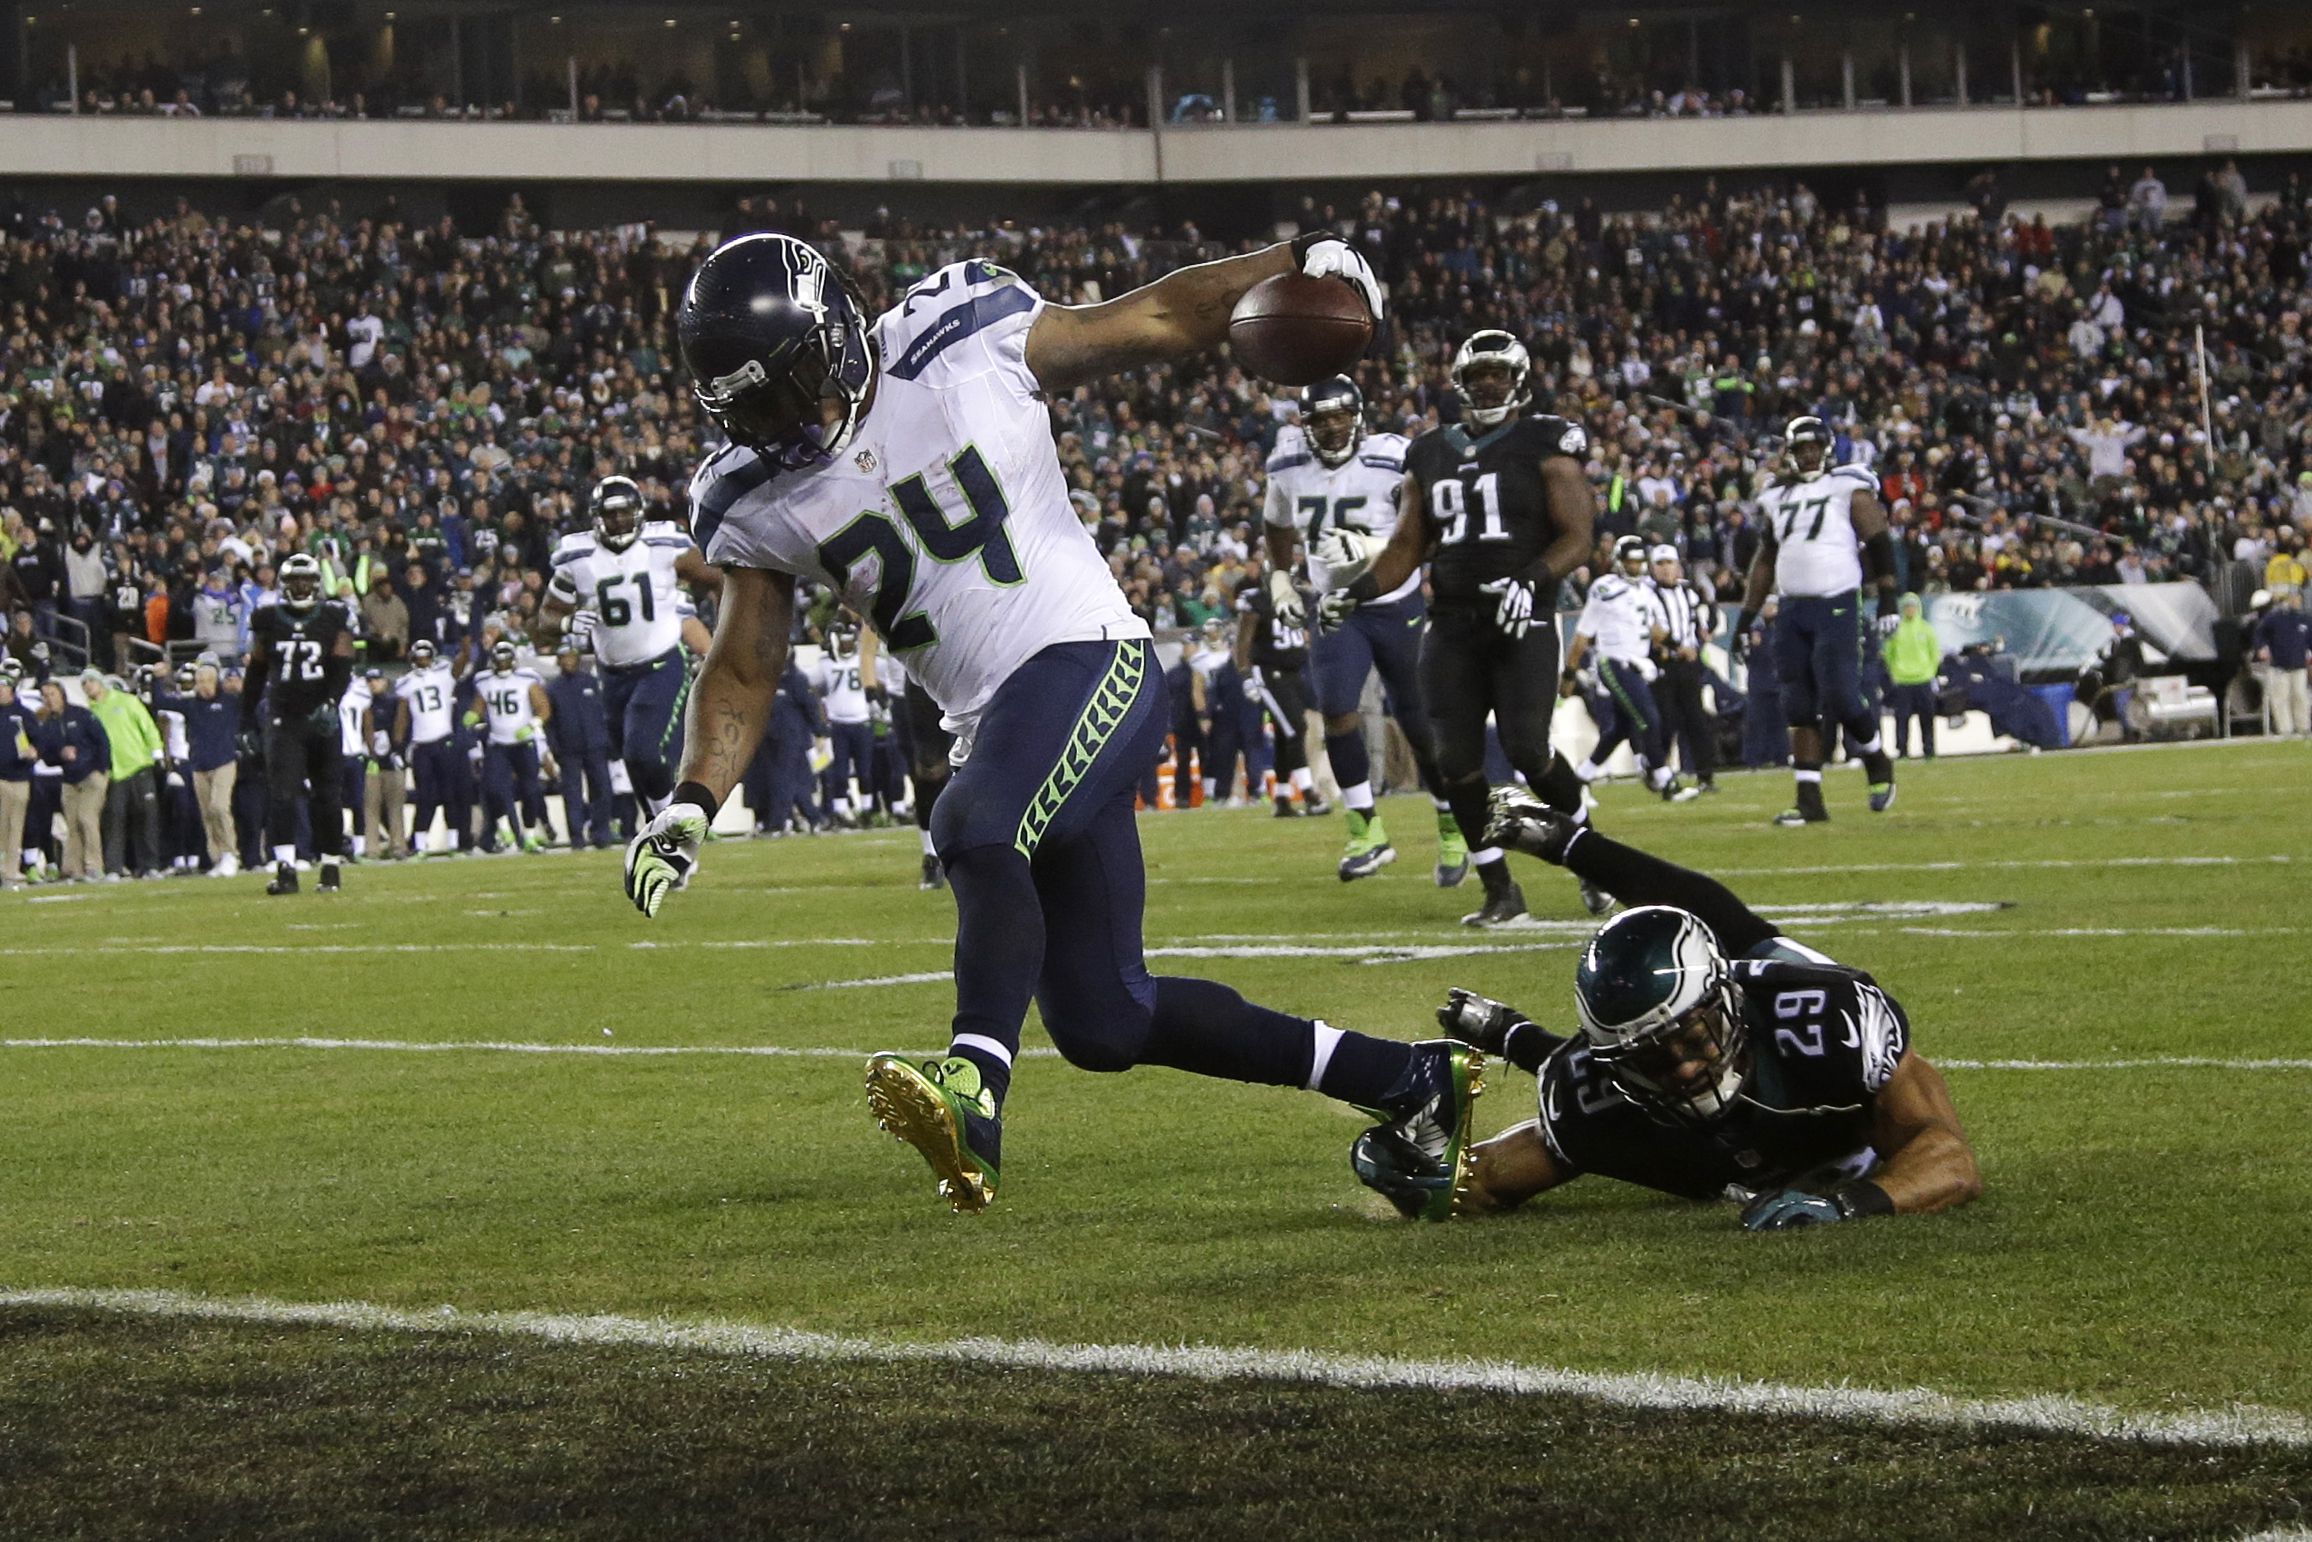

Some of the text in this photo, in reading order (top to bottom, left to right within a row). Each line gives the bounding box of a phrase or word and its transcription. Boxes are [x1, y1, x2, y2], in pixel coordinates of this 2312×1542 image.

[910, 319, 961, 365] SEAHAWKS
[1432, 472, 1512, 545] 91
[1779, 495, 1830, 541] 77
[819, 441, 1028, 653] 24
[117, 587, 139, 609] 20
[596, 571, 655, 627] 61
[275, 640, 325, 681] 72
[831, 668, 862, 692] 78
[414, 685, 442, 713] 13
[487, 689, 519, 716] 46
[1774, 989, 1827, 1058] 29
